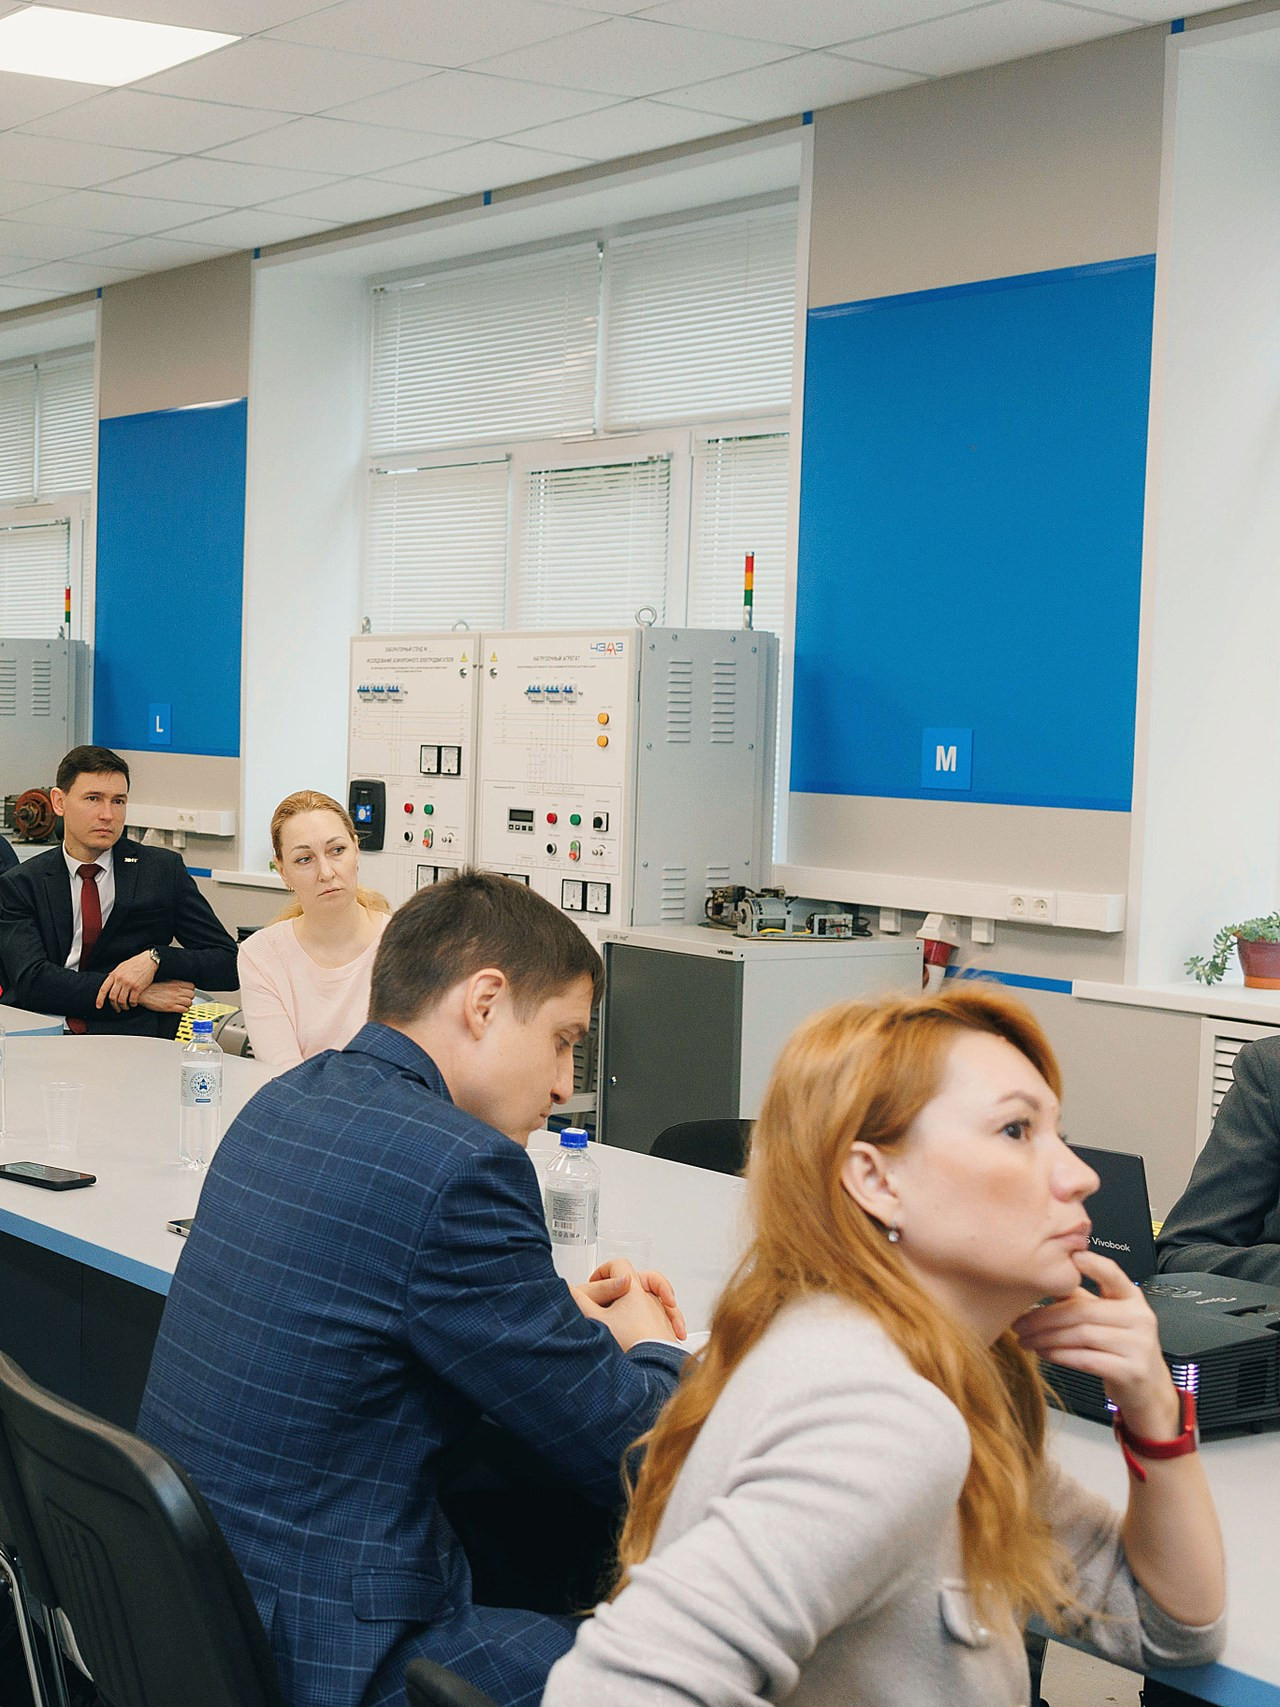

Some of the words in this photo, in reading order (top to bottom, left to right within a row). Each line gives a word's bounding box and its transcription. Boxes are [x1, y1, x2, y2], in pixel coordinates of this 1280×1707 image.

[156, 715, 164, 733] L
[935, 745, 957, 772] M
[1091, 1236, 1131, 1252] Vivobook
